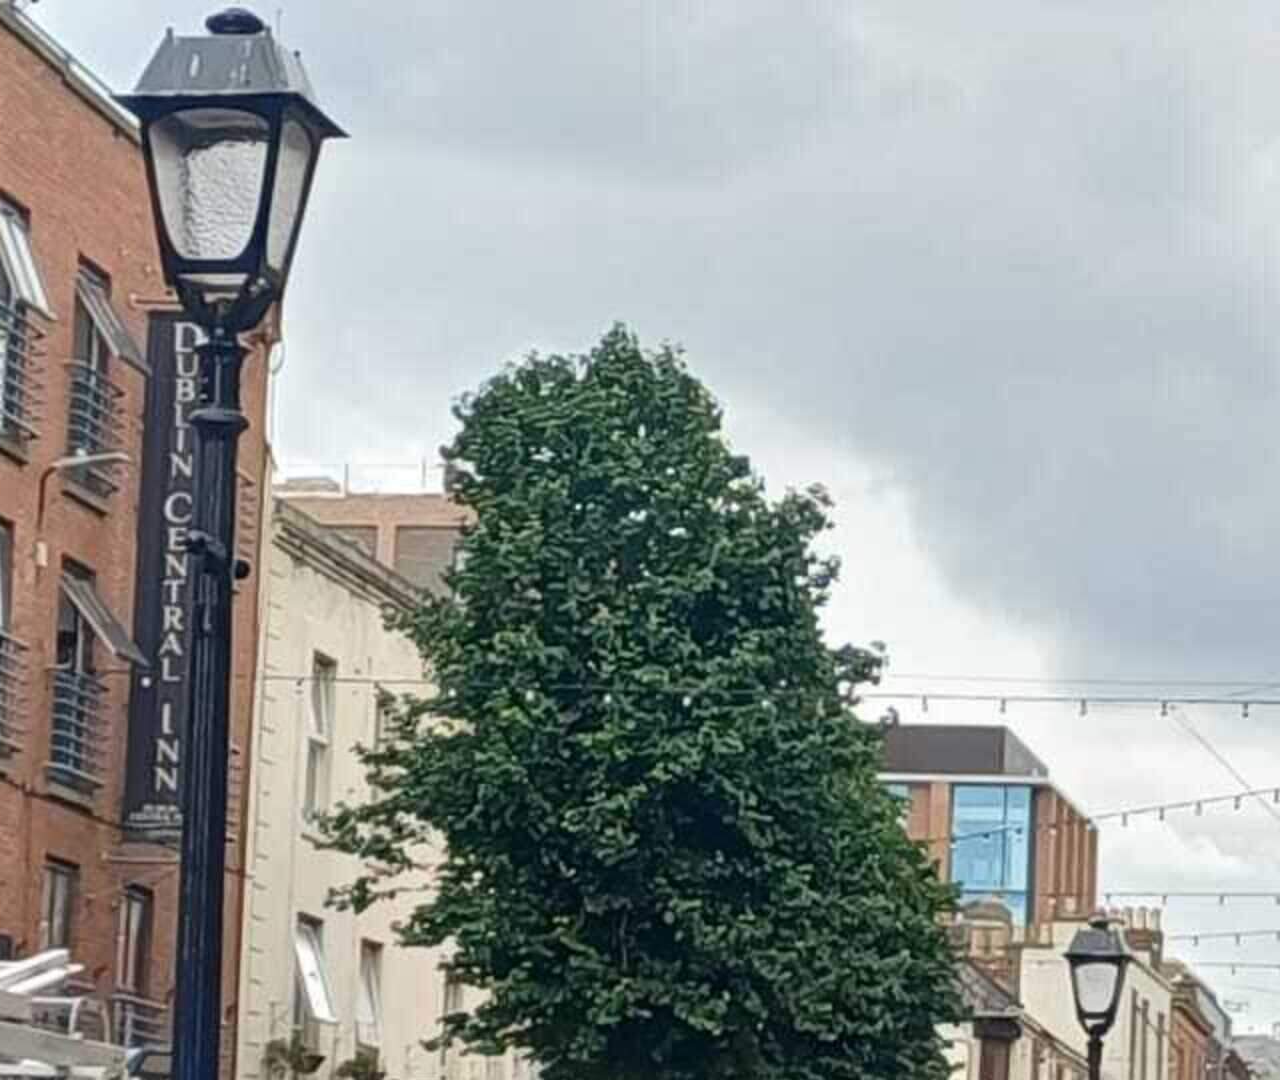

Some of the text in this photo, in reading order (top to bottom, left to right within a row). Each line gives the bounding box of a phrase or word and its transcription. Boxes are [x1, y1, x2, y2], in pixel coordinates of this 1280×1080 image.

[170, 322, 202, 479] DUBLIN
[157, 491, 194, 682] CENTRAL
[154, 704, 182, 792] INN
